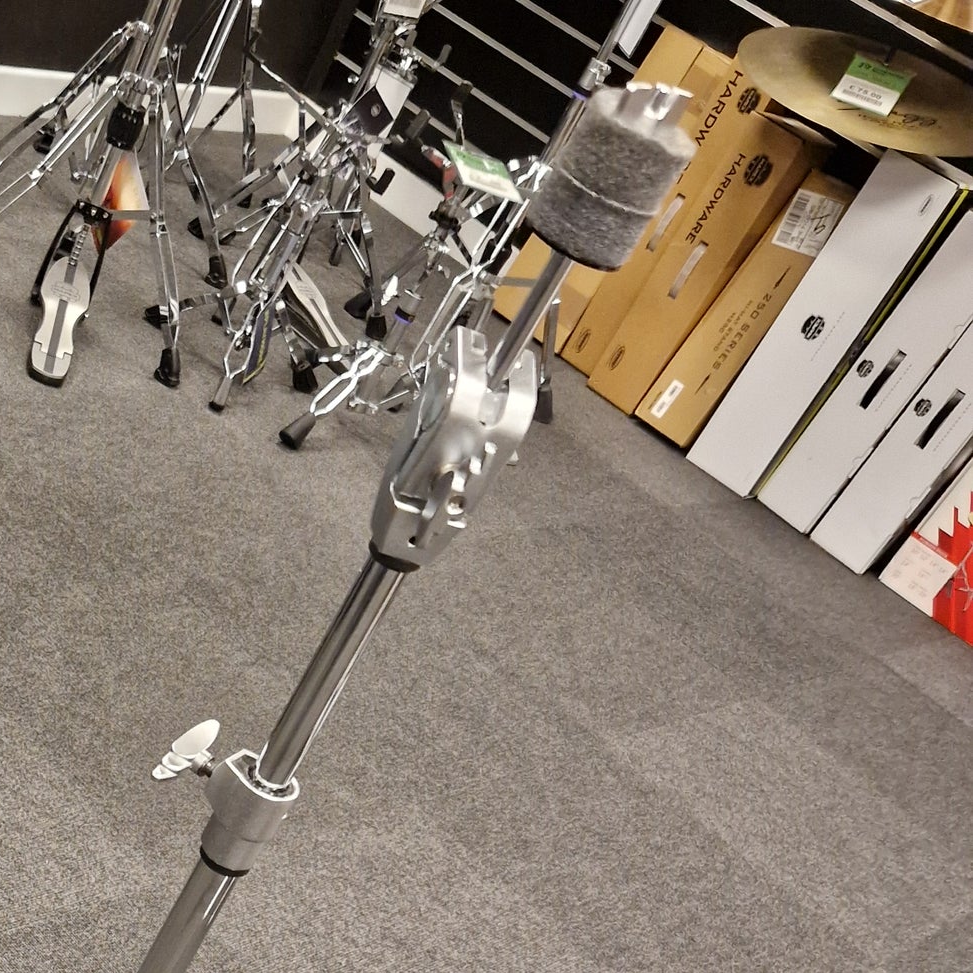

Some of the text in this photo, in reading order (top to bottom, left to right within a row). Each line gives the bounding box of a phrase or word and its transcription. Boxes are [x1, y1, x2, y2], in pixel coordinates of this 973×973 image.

[685, 153, 746, 244] HARDWARE
[712, 293, 772, 370] 250 SERIES
